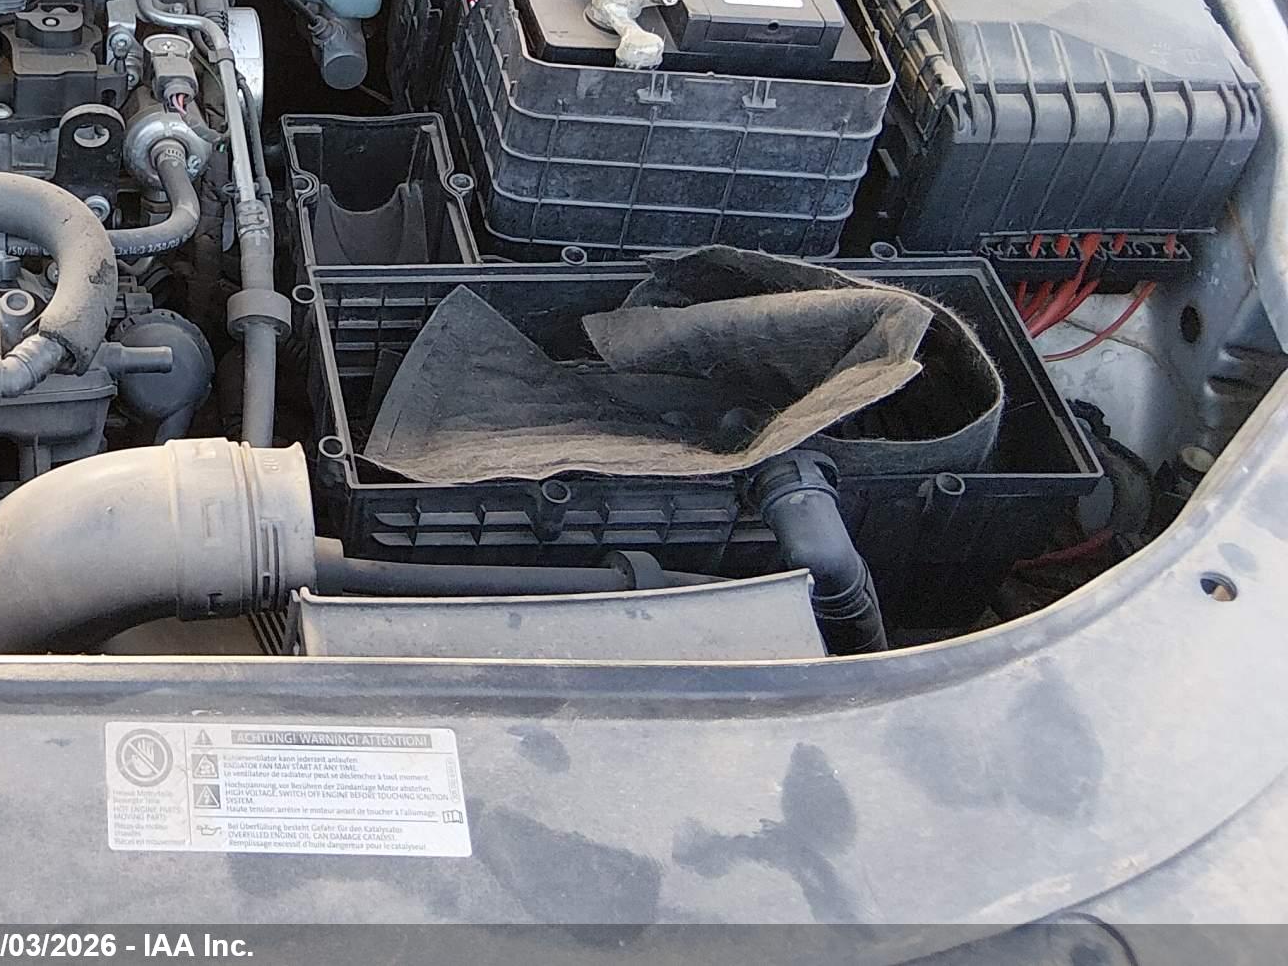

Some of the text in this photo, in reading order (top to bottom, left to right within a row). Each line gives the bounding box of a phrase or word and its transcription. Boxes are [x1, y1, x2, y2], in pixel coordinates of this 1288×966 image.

[237, 732, 428, 747] ACHTUNG! WARNING! ATTENTION!
[292, 763, 313, 771] START
